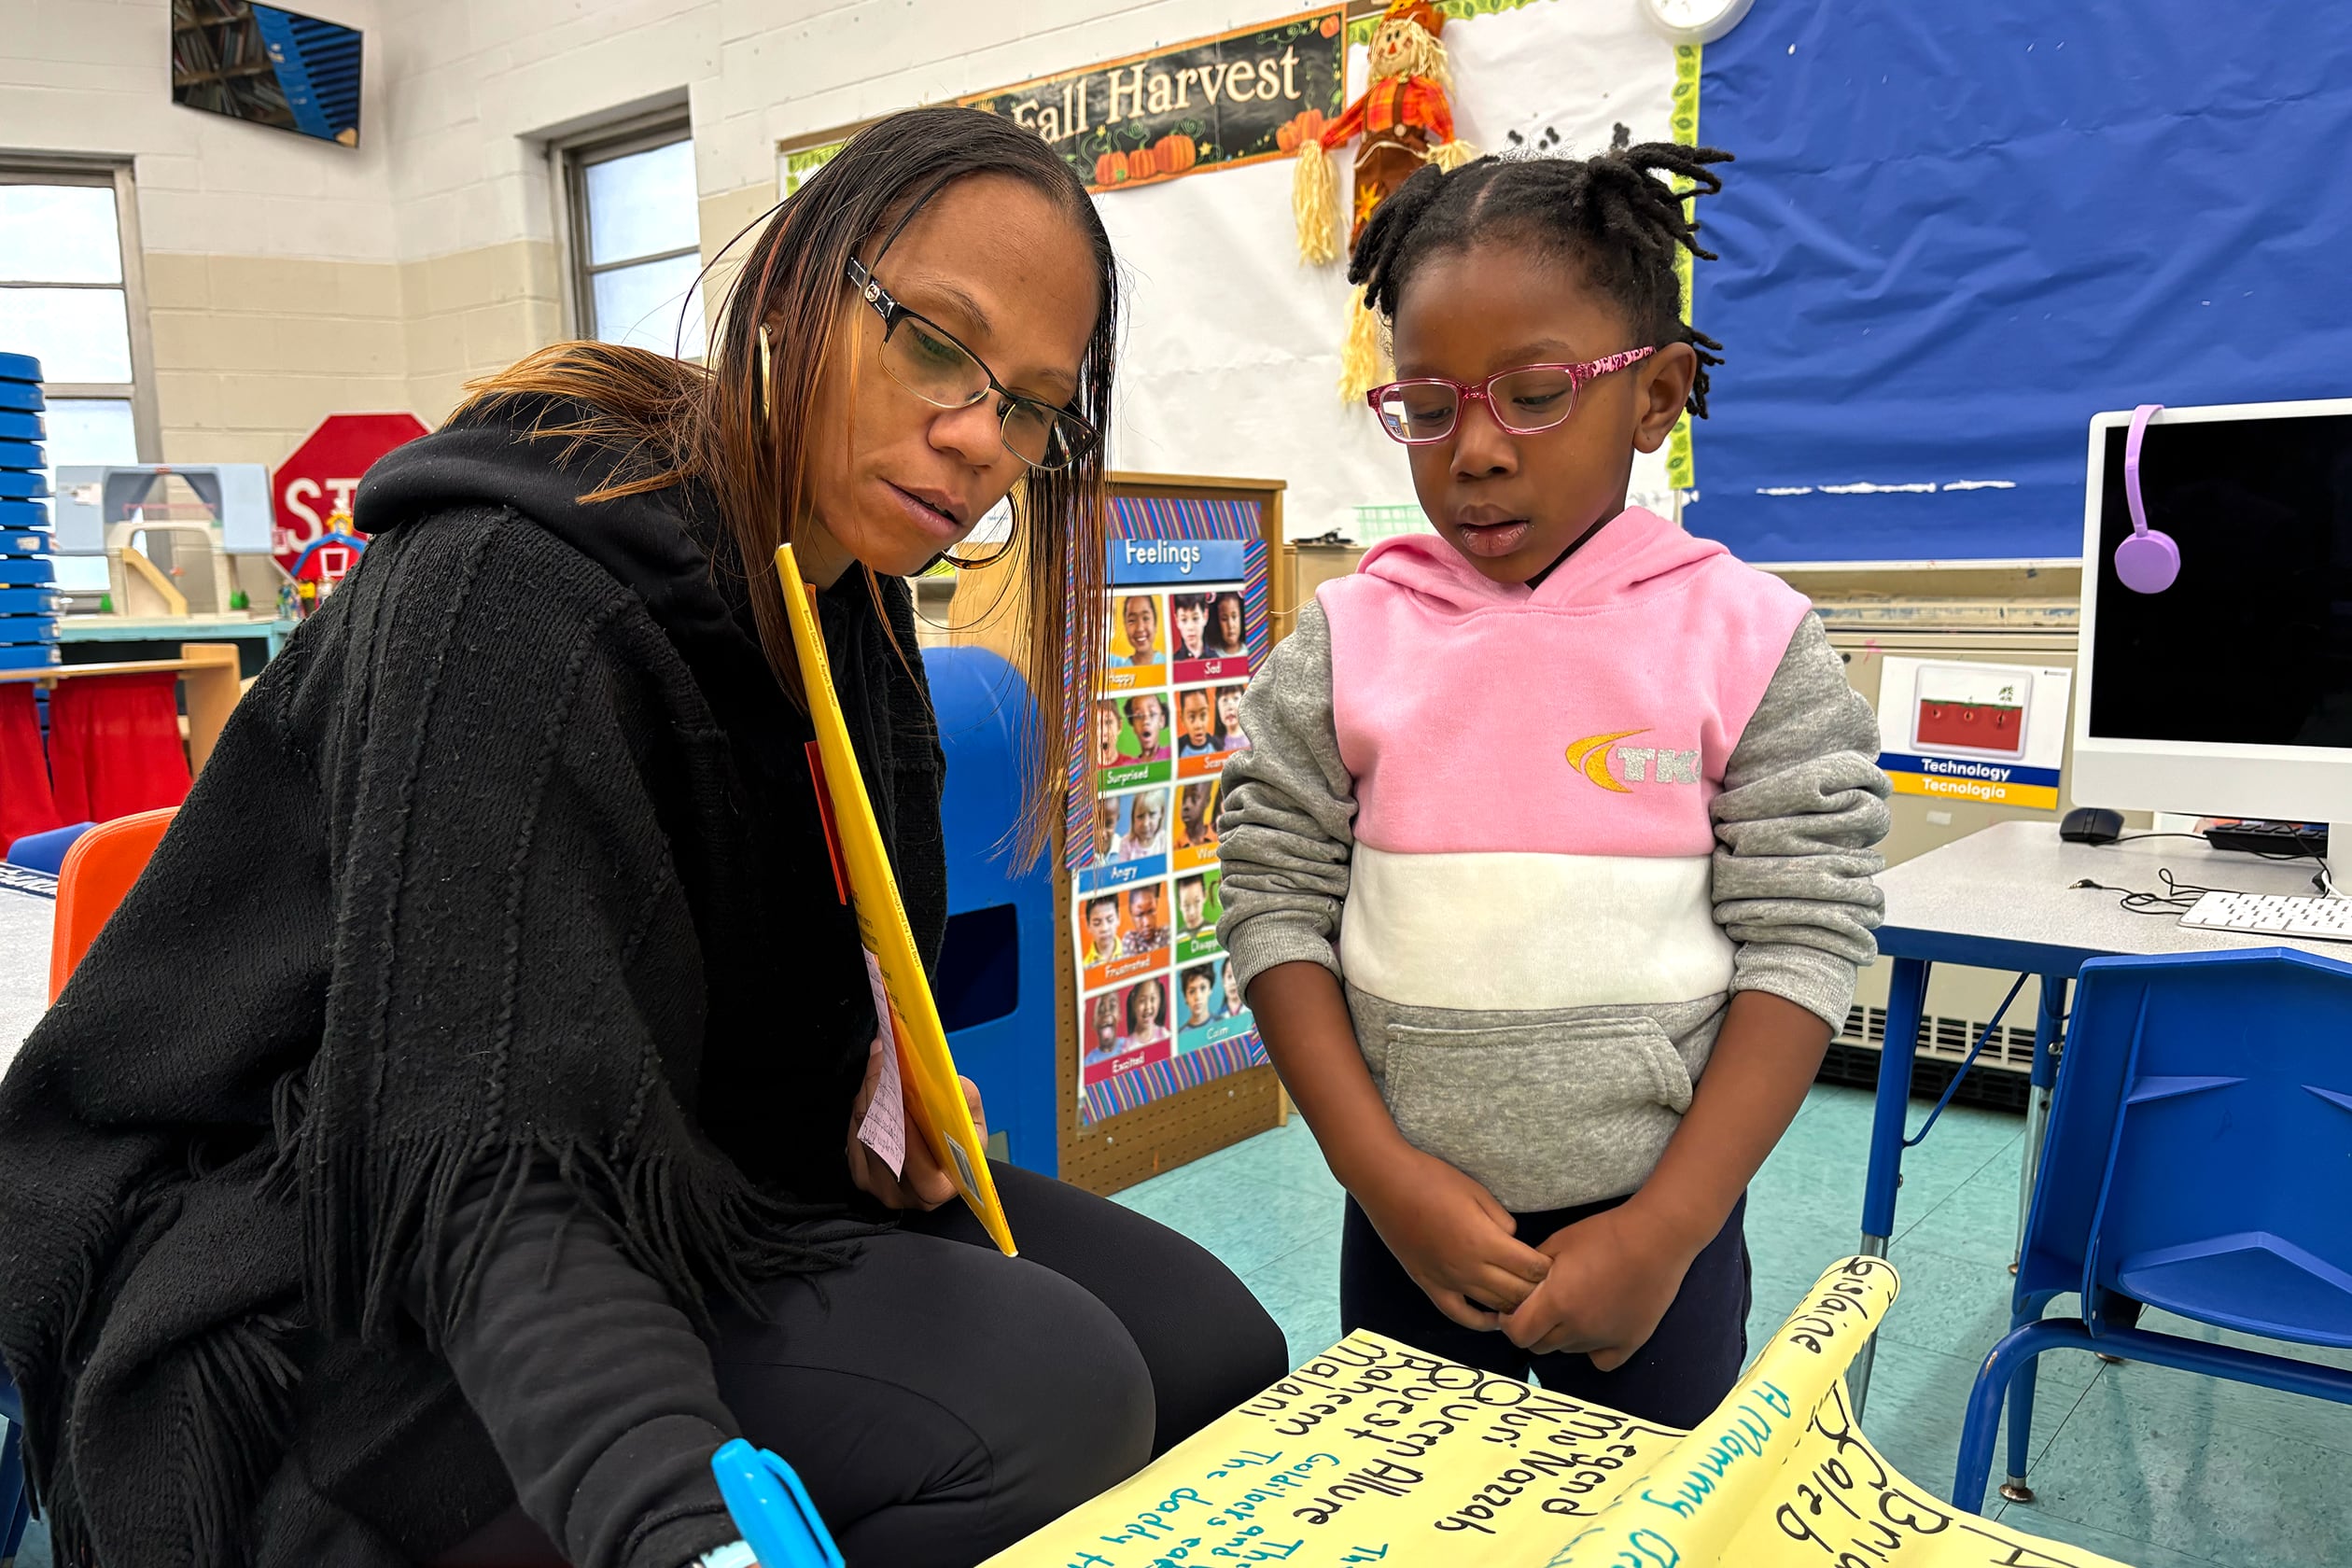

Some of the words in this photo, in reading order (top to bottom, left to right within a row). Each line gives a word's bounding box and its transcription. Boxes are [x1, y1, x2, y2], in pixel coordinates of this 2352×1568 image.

[1011, 77, 1090, 145] Fall
[1105, 45, 1301, 125] Harvest
[285, 478, 360, 553] ST
[1126, 539, 1201, 574] Feelings
[1204, 662, 1222, 676] Sad
[1107, 764, 1150, 787] Surprised
[1921, 758, 2011, 782] Technology
[1922, 777, 2006, 800] Tecnología
[1111, 865, 1138, 882] Angry
[1105, 954, 1151, 979] Frustrated
[1112, 1051, 1145, 1073] Excited
[1239, 1337, 1388, 1421] Malani
[1275, 1351, 1443, 1435] Raheem
[1344, 1364, 1485, 1443] Quest
[1481, 1395, 1584, 1449] Nuri
[1207, 1450, 1283, 1479] The
[1207, 1452, 1340, 1526] Goldilocks
[1541, 1425, 1689, 1517] Legend
[1640, 1405, 1771, 1519] Mommy
[1099, 1488, 1214, 1545] daddy
[1775, 1435, 1888, 1554] Caleb
